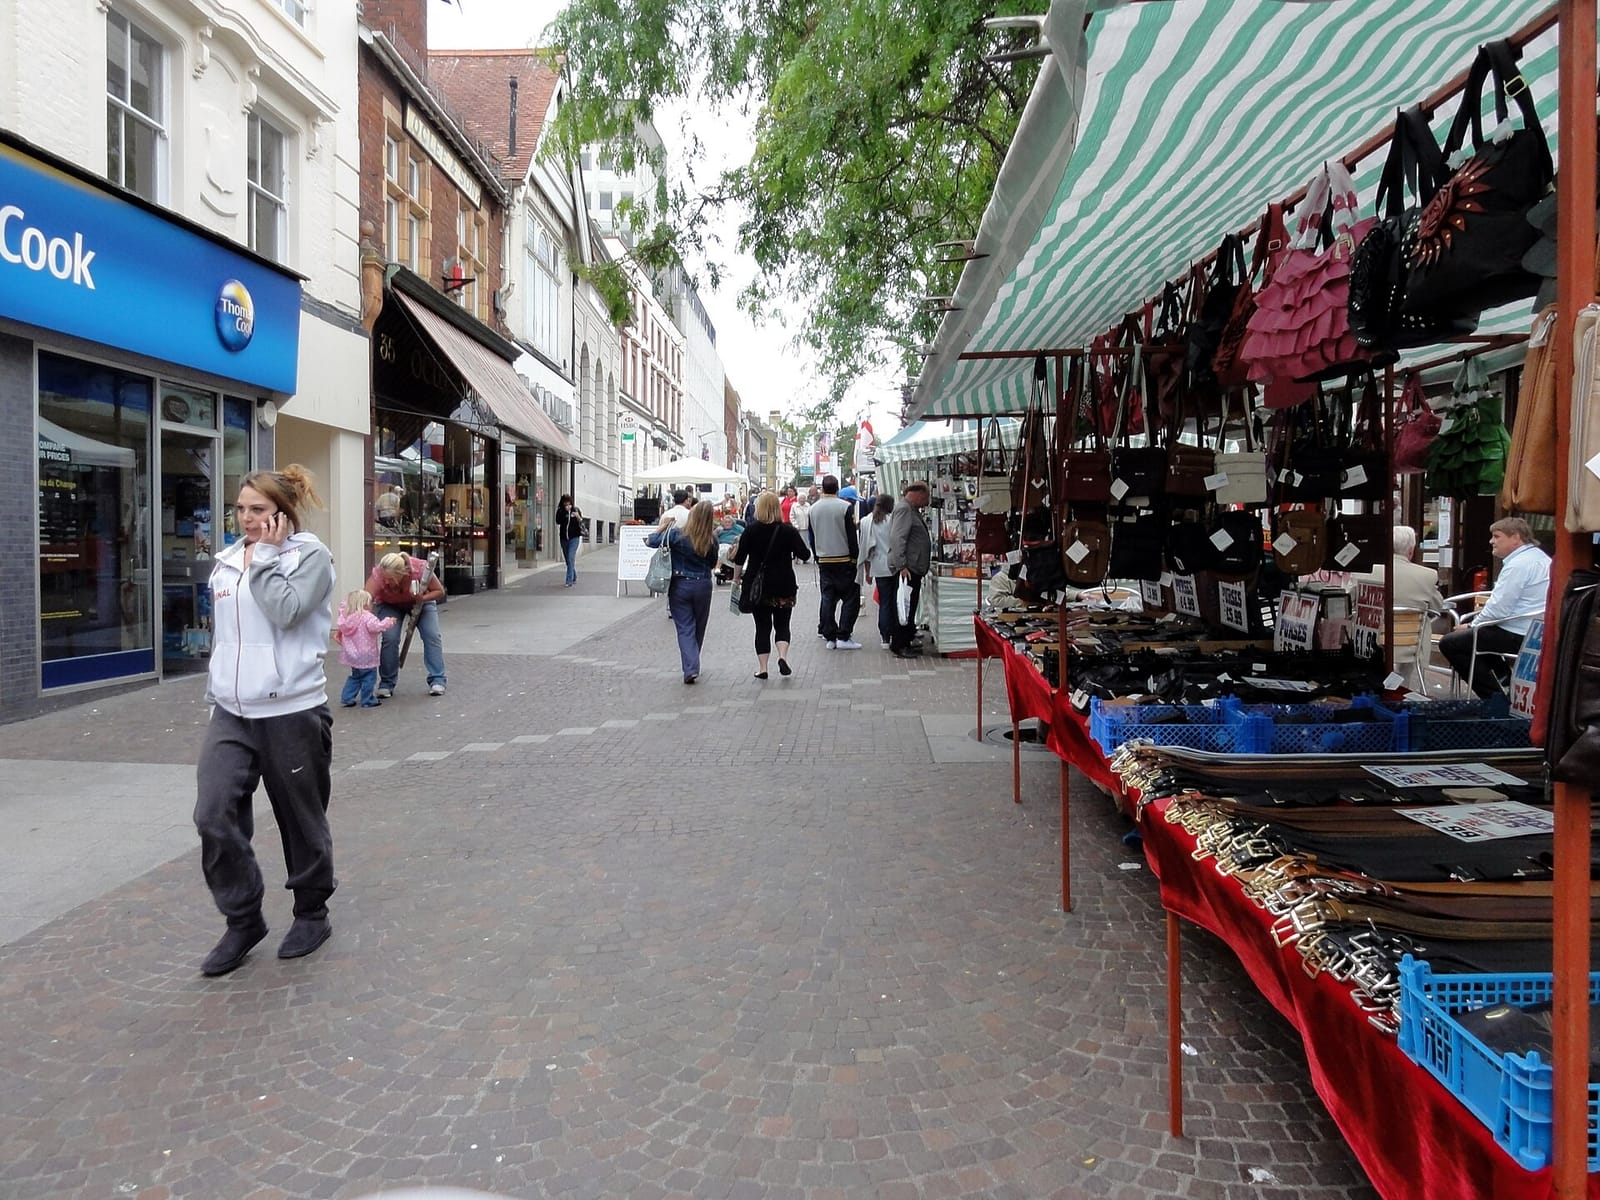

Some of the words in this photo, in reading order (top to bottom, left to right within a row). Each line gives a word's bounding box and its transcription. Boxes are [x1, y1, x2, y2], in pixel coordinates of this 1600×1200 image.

[0, 205, 96, 290] Cook
[39, 441, 66, 452] OMPARE
[47, 451, 70, 461] PRICES
[1221, 586, 1242, 608] PURSES
[1280, 619, 1308, 643] PURSES
